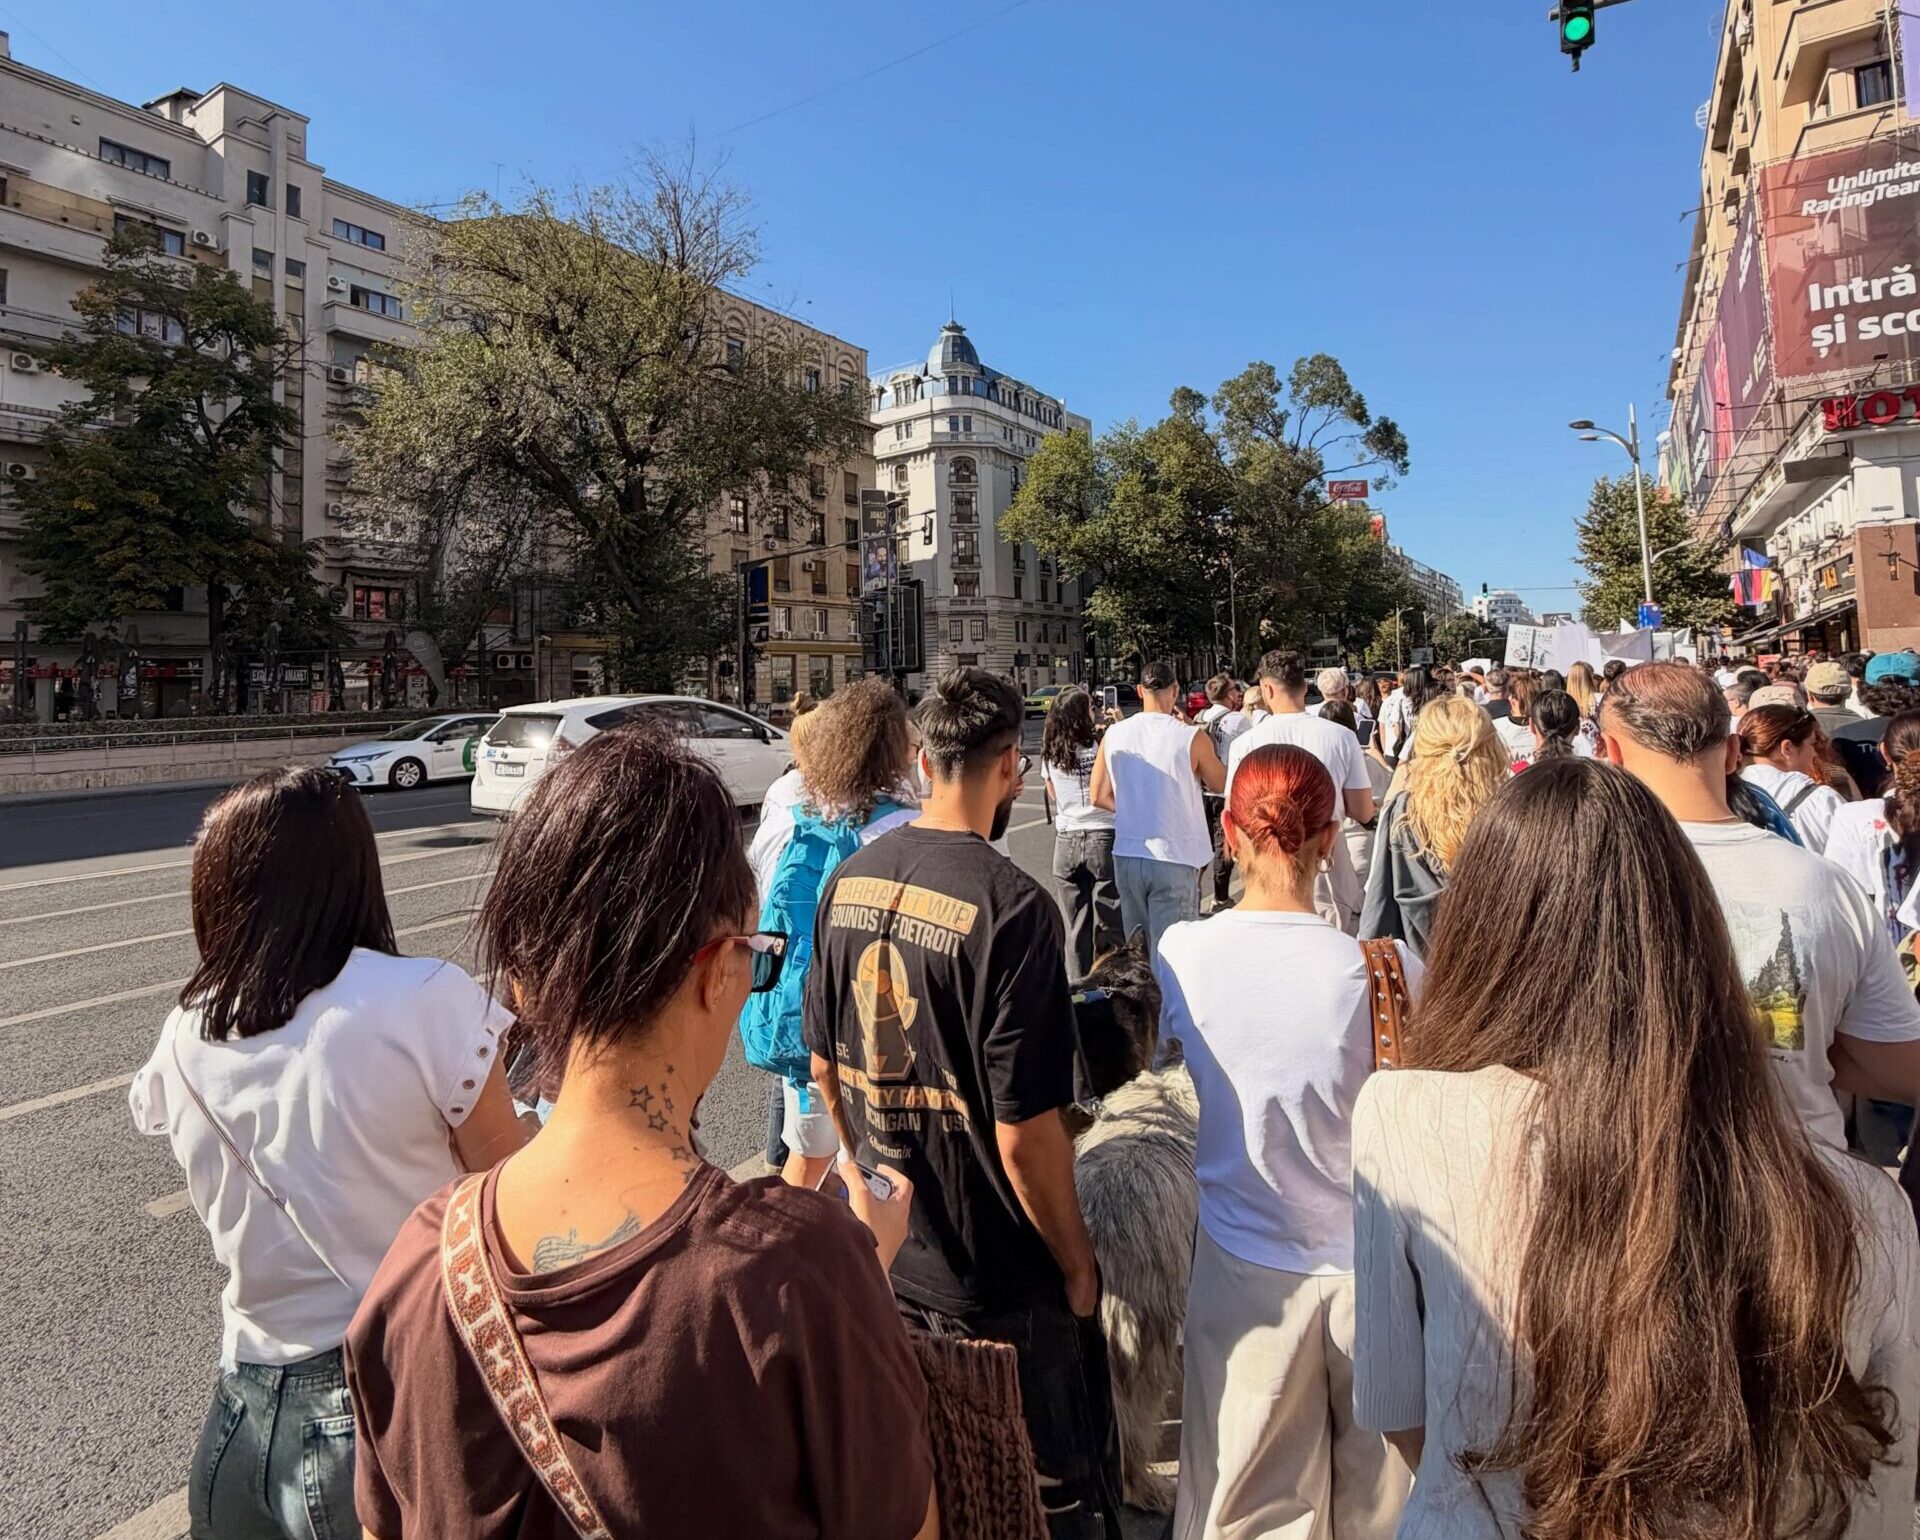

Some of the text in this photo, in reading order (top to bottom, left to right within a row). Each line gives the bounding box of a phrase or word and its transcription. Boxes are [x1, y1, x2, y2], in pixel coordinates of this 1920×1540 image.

[1809, 264, 1917, 312] Intră
[1811, 313, 1847, 358] și
[1856, 743, 1880, 754] TH
[927, 896, 971, 926] WIP
[831, 905, 879, 932] SOUNDS
[898, 915, 965, 958] DETROIT
[836, 1042, 849, 1059] ST:
